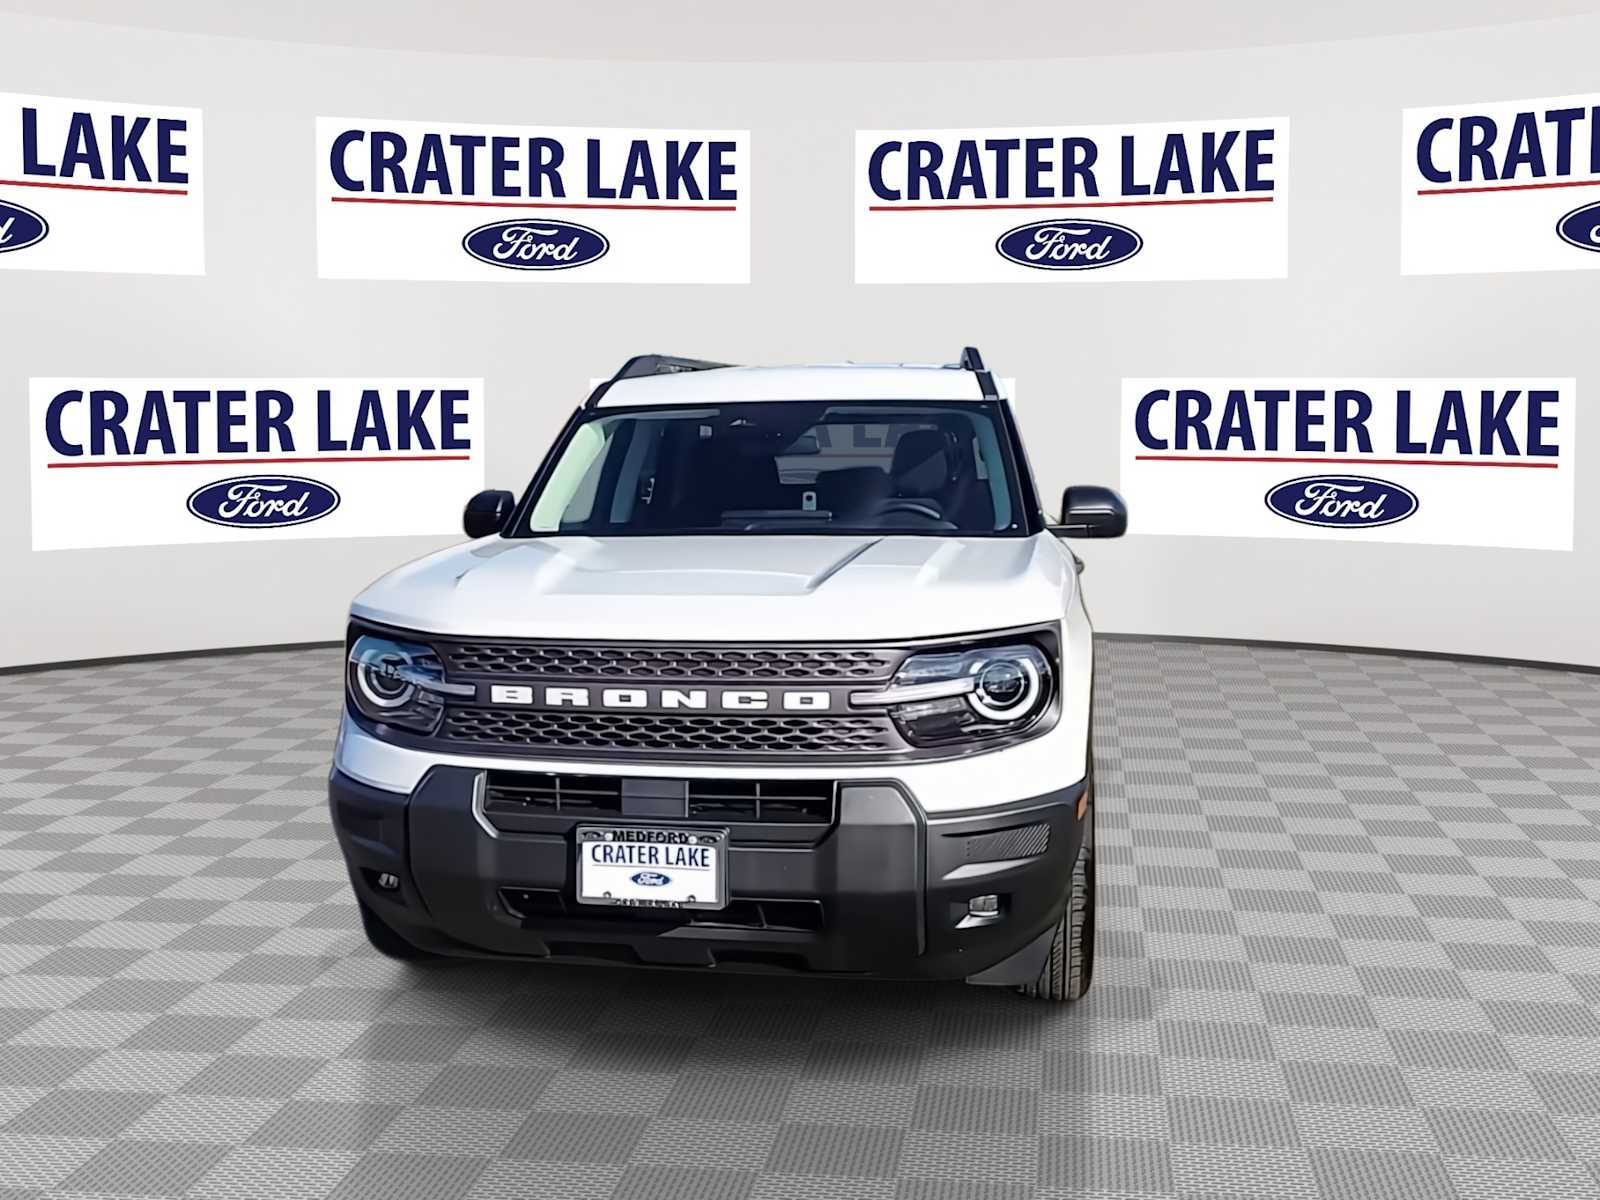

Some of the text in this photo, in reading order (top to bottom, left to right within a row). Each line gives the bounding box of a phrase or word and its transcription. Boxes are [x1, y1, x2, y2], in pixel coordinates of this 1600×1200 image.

[22, 107, 189, 184] LAKE
[1416, 105, 1600, 184] CRAT
[329, 129, 738, 201] CRATER LAKE
[868, 128, 1275, 202] CRATER LAKE
[493, 226, 580, 261] Ford
[1025, 226, 1113, 261] Ford
[45, 389, 471, 457] CRATER LAKE
[1134, 389, 1560, 457] CRATER LAKE
[218, 483, 310, 518] Ford
[1294, 482, 1388, 519] Ford
[490, 684, 832, 711] BRONCO
[612, 830, 688, 844] MEDFORD
[591, 844, 711, 868] CRATER LAKE
